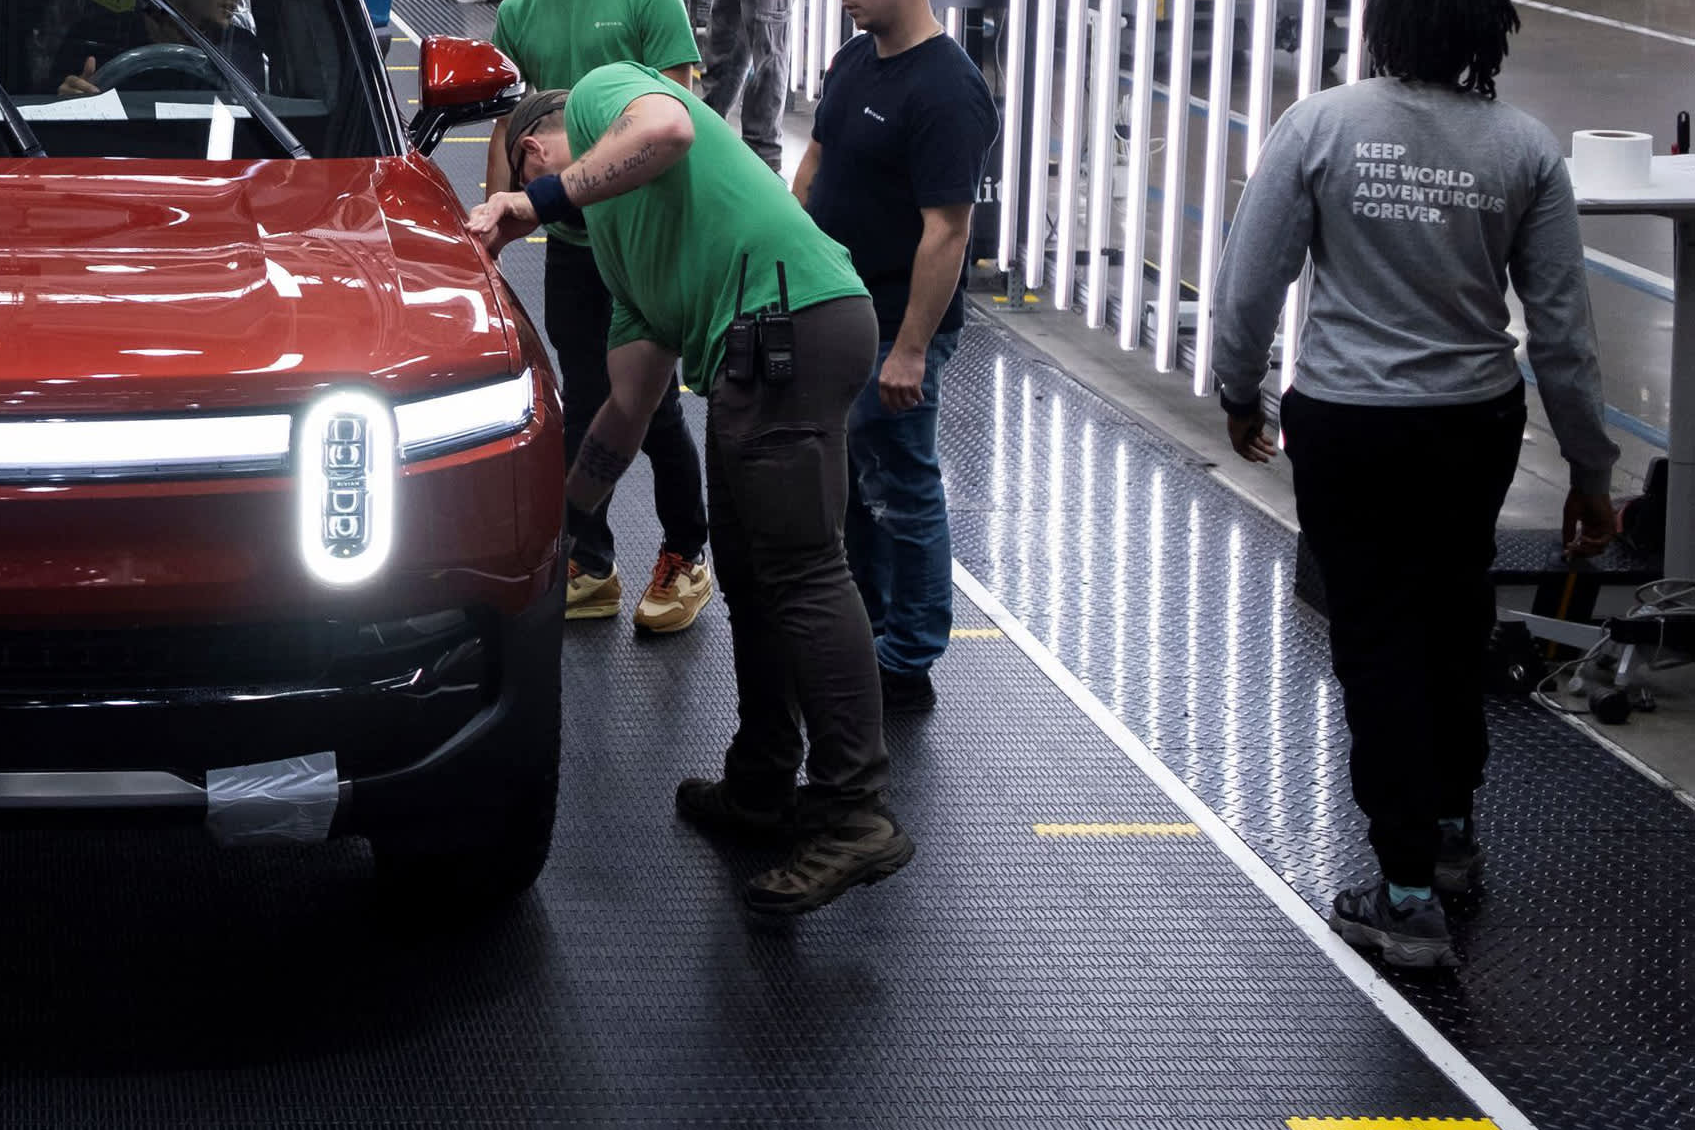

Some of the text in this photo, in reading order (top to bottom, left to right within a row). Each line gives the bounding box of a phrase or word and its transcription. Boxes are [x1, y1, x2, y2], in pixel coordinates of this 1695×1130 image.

[1355, 142, 1407, 160] KEEP
[1355, 162, 1475, 187] THE WORLD
[1355, 183, 1506, 214] ADVENTUROUS
[1352, 201, 1446, 224] FOREVER.
